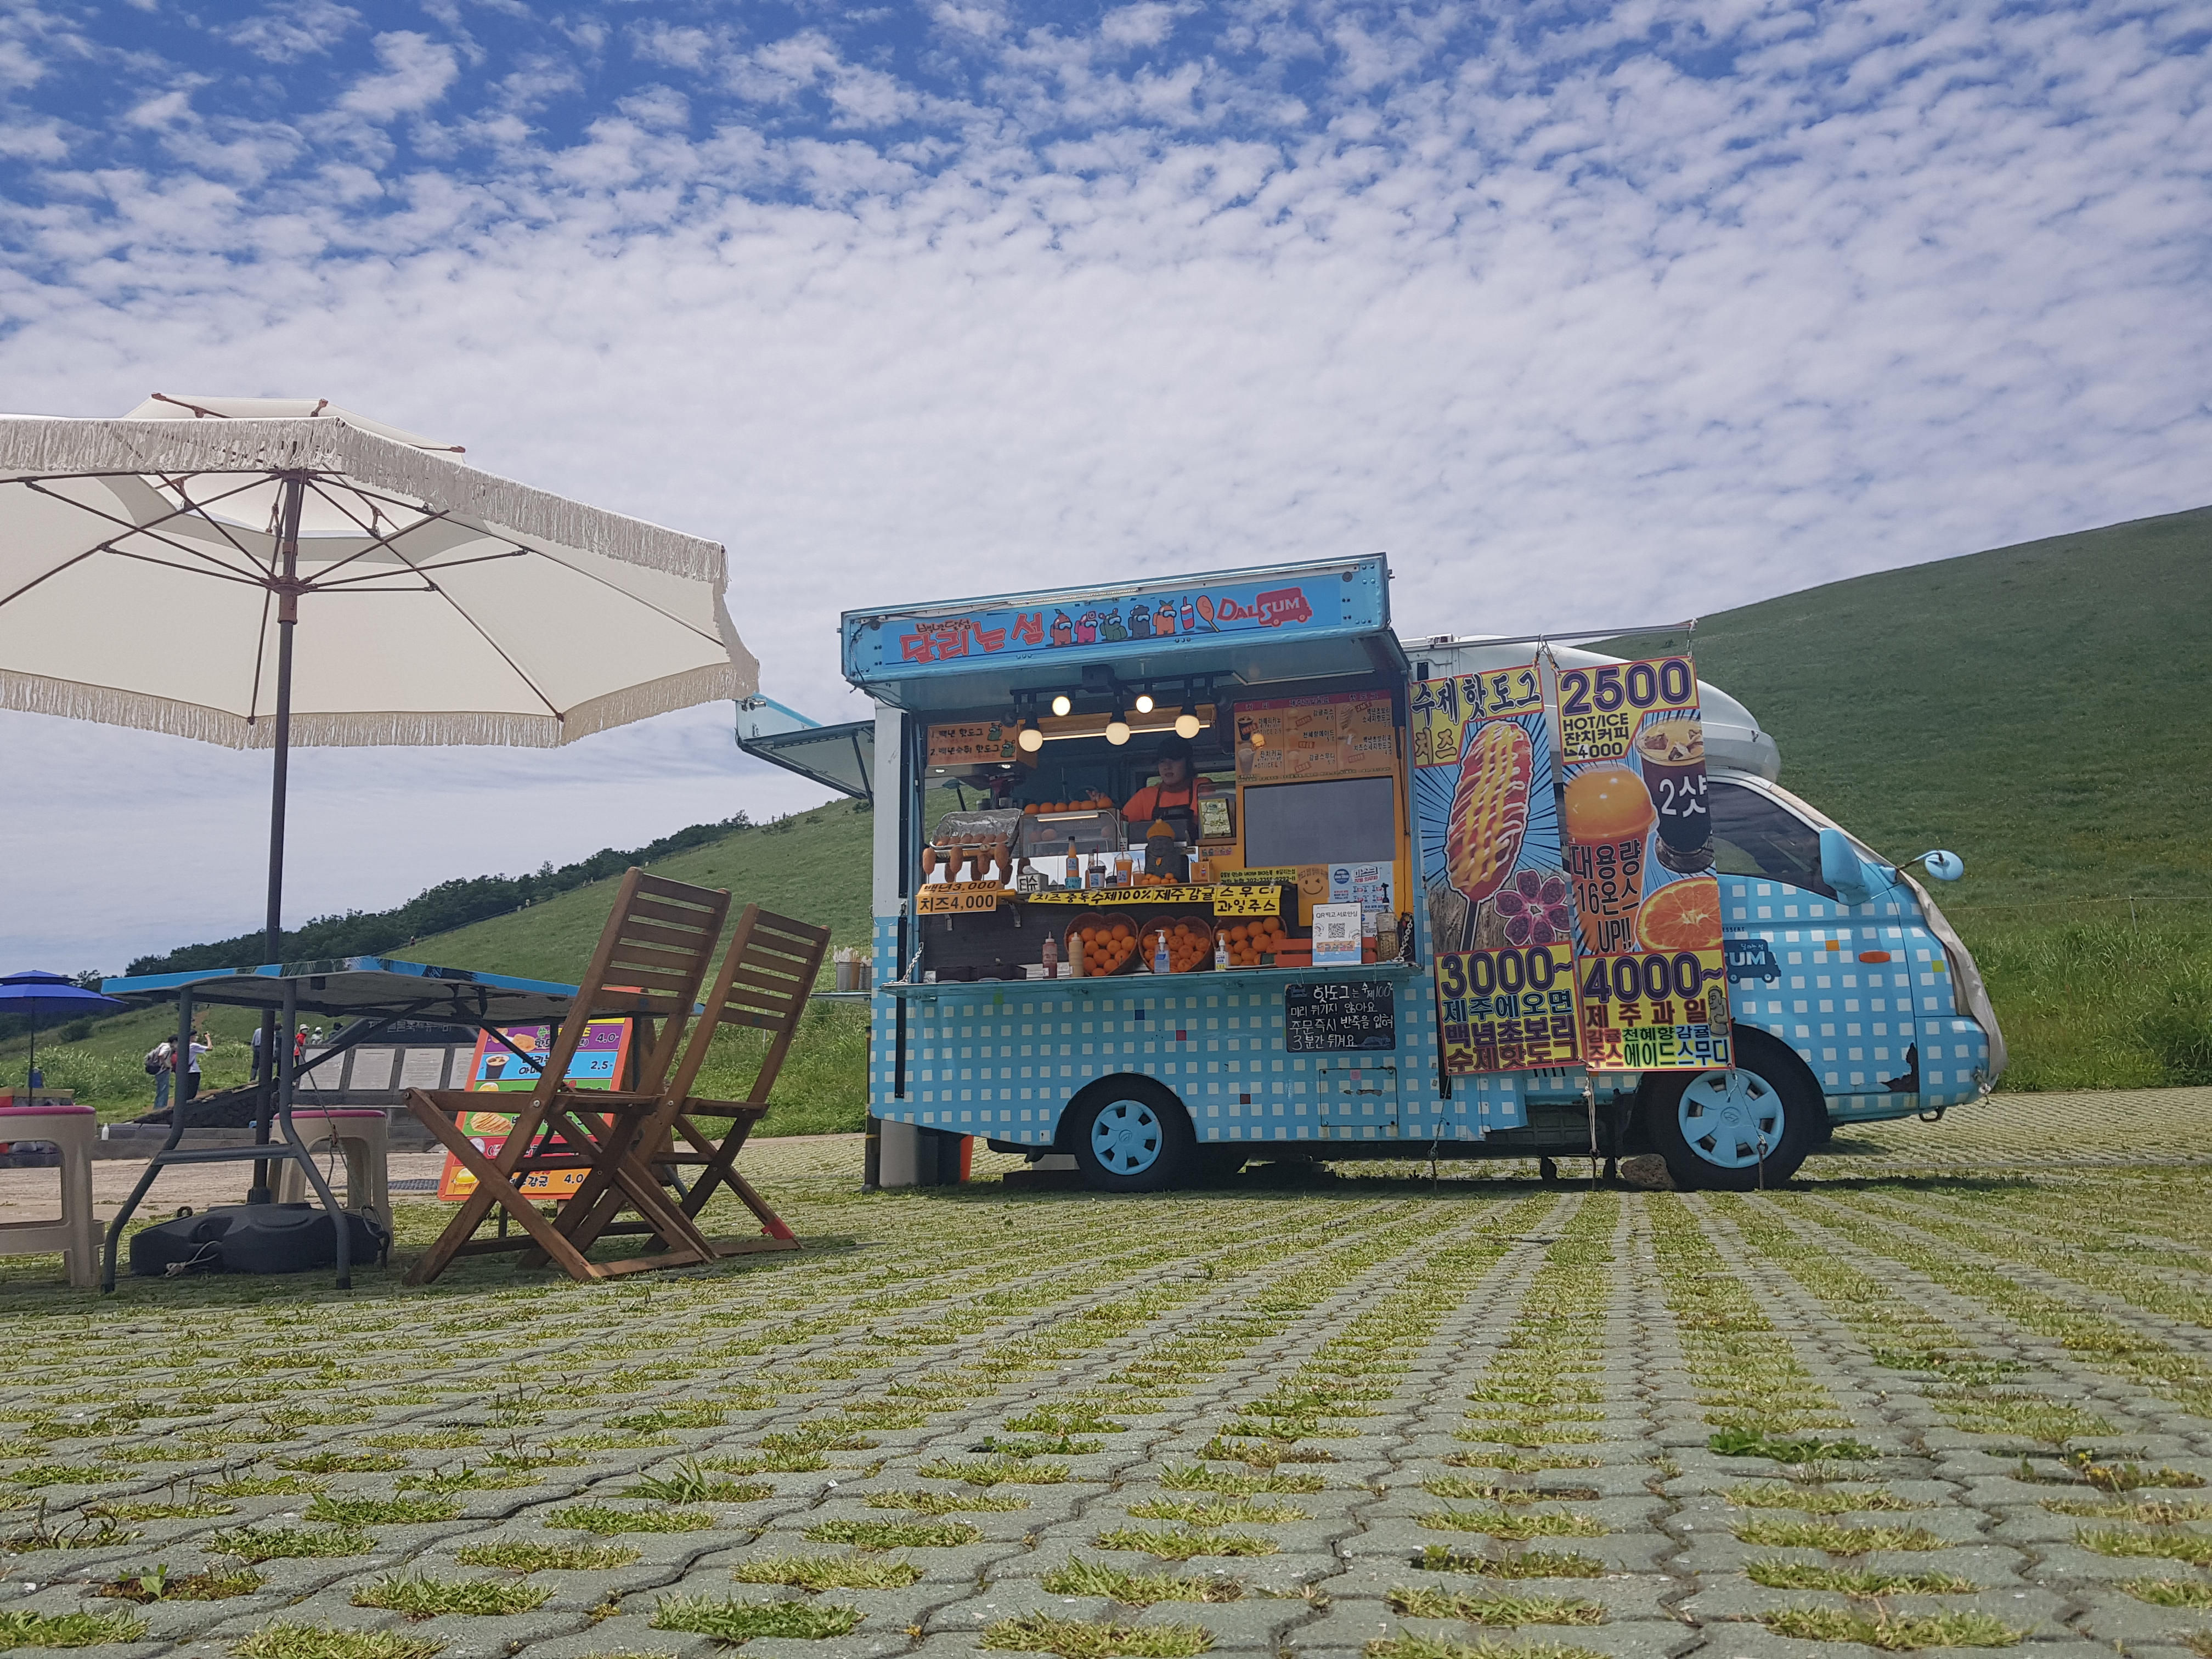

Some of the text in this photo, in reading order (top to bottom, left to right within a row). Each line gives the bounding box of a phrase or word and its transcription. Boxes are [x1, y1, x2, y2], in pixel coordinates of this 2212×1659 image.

[1561, 659, 1692, 716] 2500
[1357, 702, 1370, 711] JMT
[1564, 713, 1628, 731] HOT/ICE
[1565, 727, 1629, 746] 잔치커피
[1415, 727, 1457, 764] 치즈
[1578, 743, 1623, 758] 4000
[1660, 775, 1708, 817] 2샷
[1571, 839, 1641, 880] 대용량
[1019, 879, 1040, 893] 티슈
[1154, 887, 1215, 901] 제주감귤
[1578, 877, 1640, 916] 16온스
[1217, 899, 1276, 913] 과일주스
[1598, 917, 1632, 953] UP!!
[1725, 951, 1766, 966] UM
[1291, 1006, 1307, 1017] 미리
[1345, 1002, 1378, 1014] 않아요
[1340, 1015, 1370, 1030] 반죽을
[596, 1034, 616, 1043] 4.0
[1445, 1015, 1576, 1048] 백년초보리
[1587, 1024, 1710, 1044] 감귤 천혜향 감귤
[1327, 1034, 1358, 1048] 튀겨요
[1447, 1039, 1579, 1073] 수제핫도그
[1588, 1039, 1729, 1068] 주스 에이드 스무디
[590, 1060, 609, 1070] 2.5
[564, 1174, 584, 1184] 4.0
